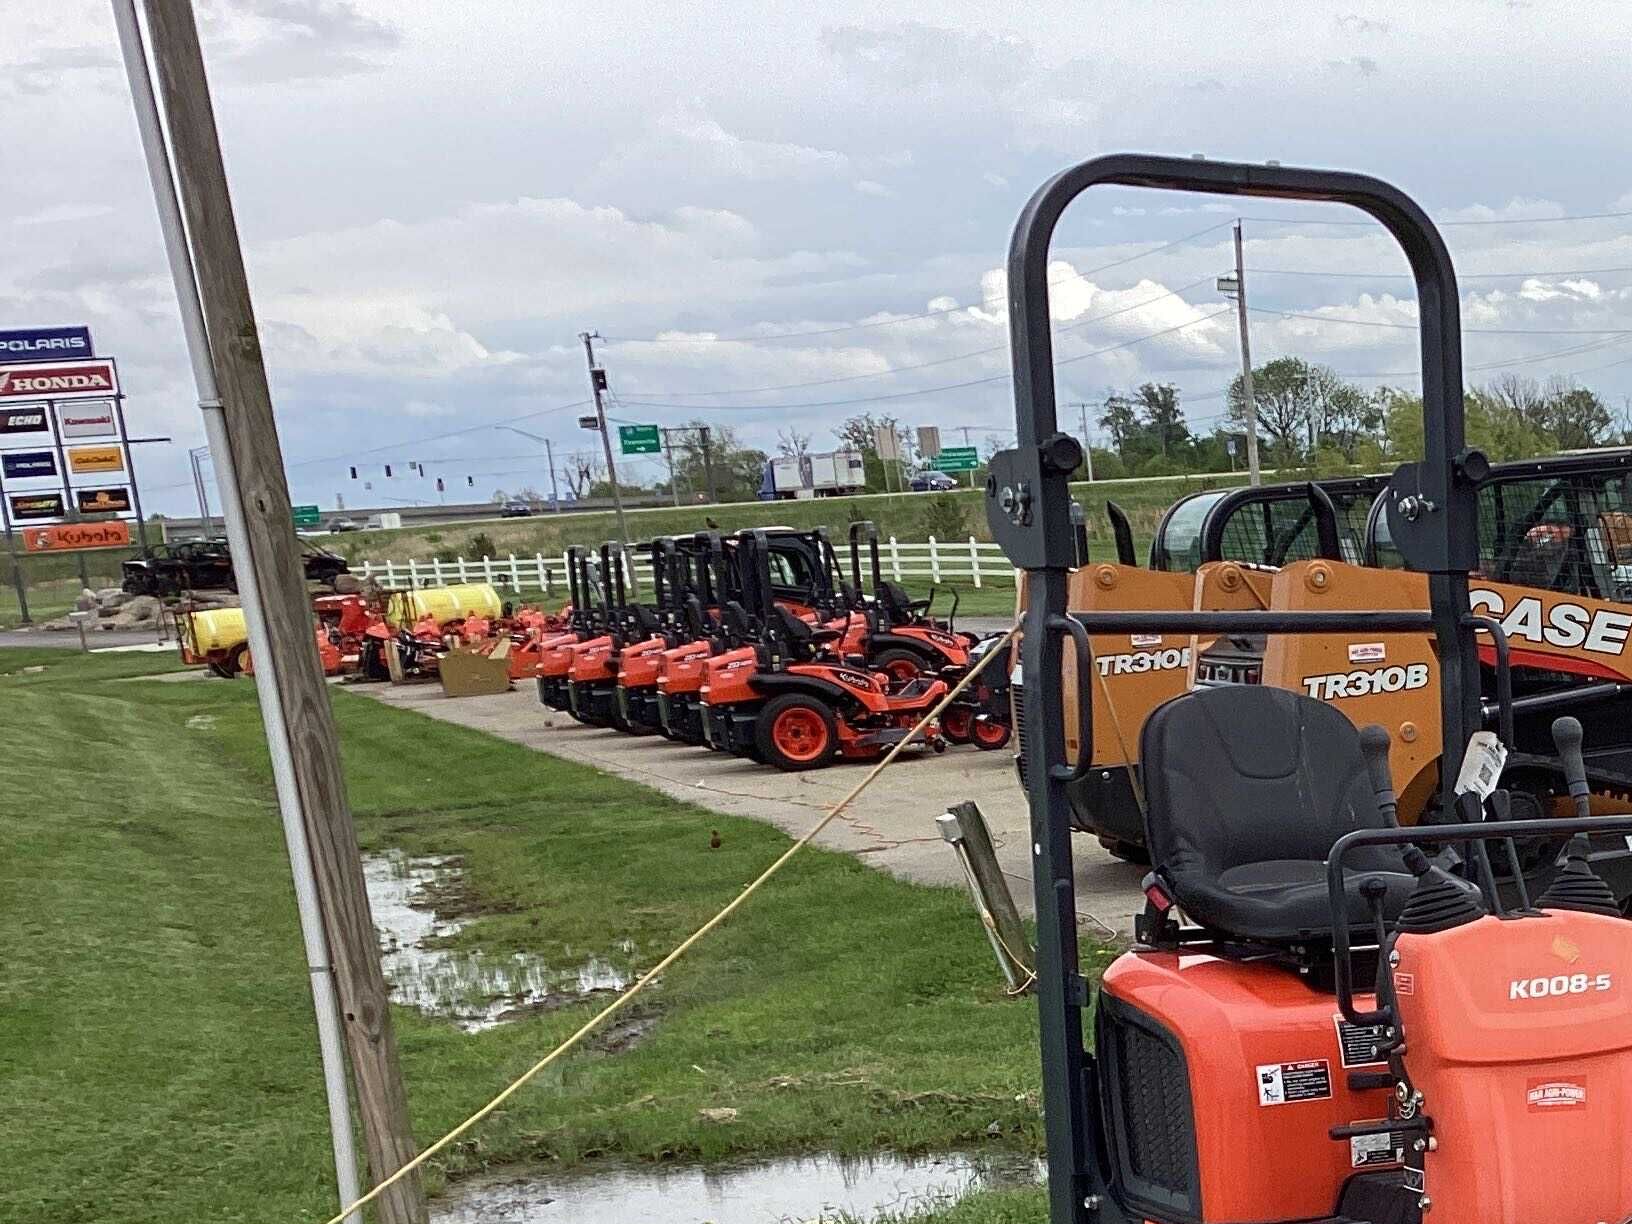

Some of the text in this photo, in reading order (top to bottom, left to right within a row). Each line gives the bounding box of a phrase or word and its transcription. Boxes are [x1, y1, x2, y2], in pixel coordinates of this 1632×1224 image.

[11, 374, 110, 391] HONDA
[8, 414, 42, 426] ECHO
[57, 528, 122, 544] Kubota
[1303, 664, 1429, 700] TR310B
[1509, 973, 1612, 1000] K008-5
